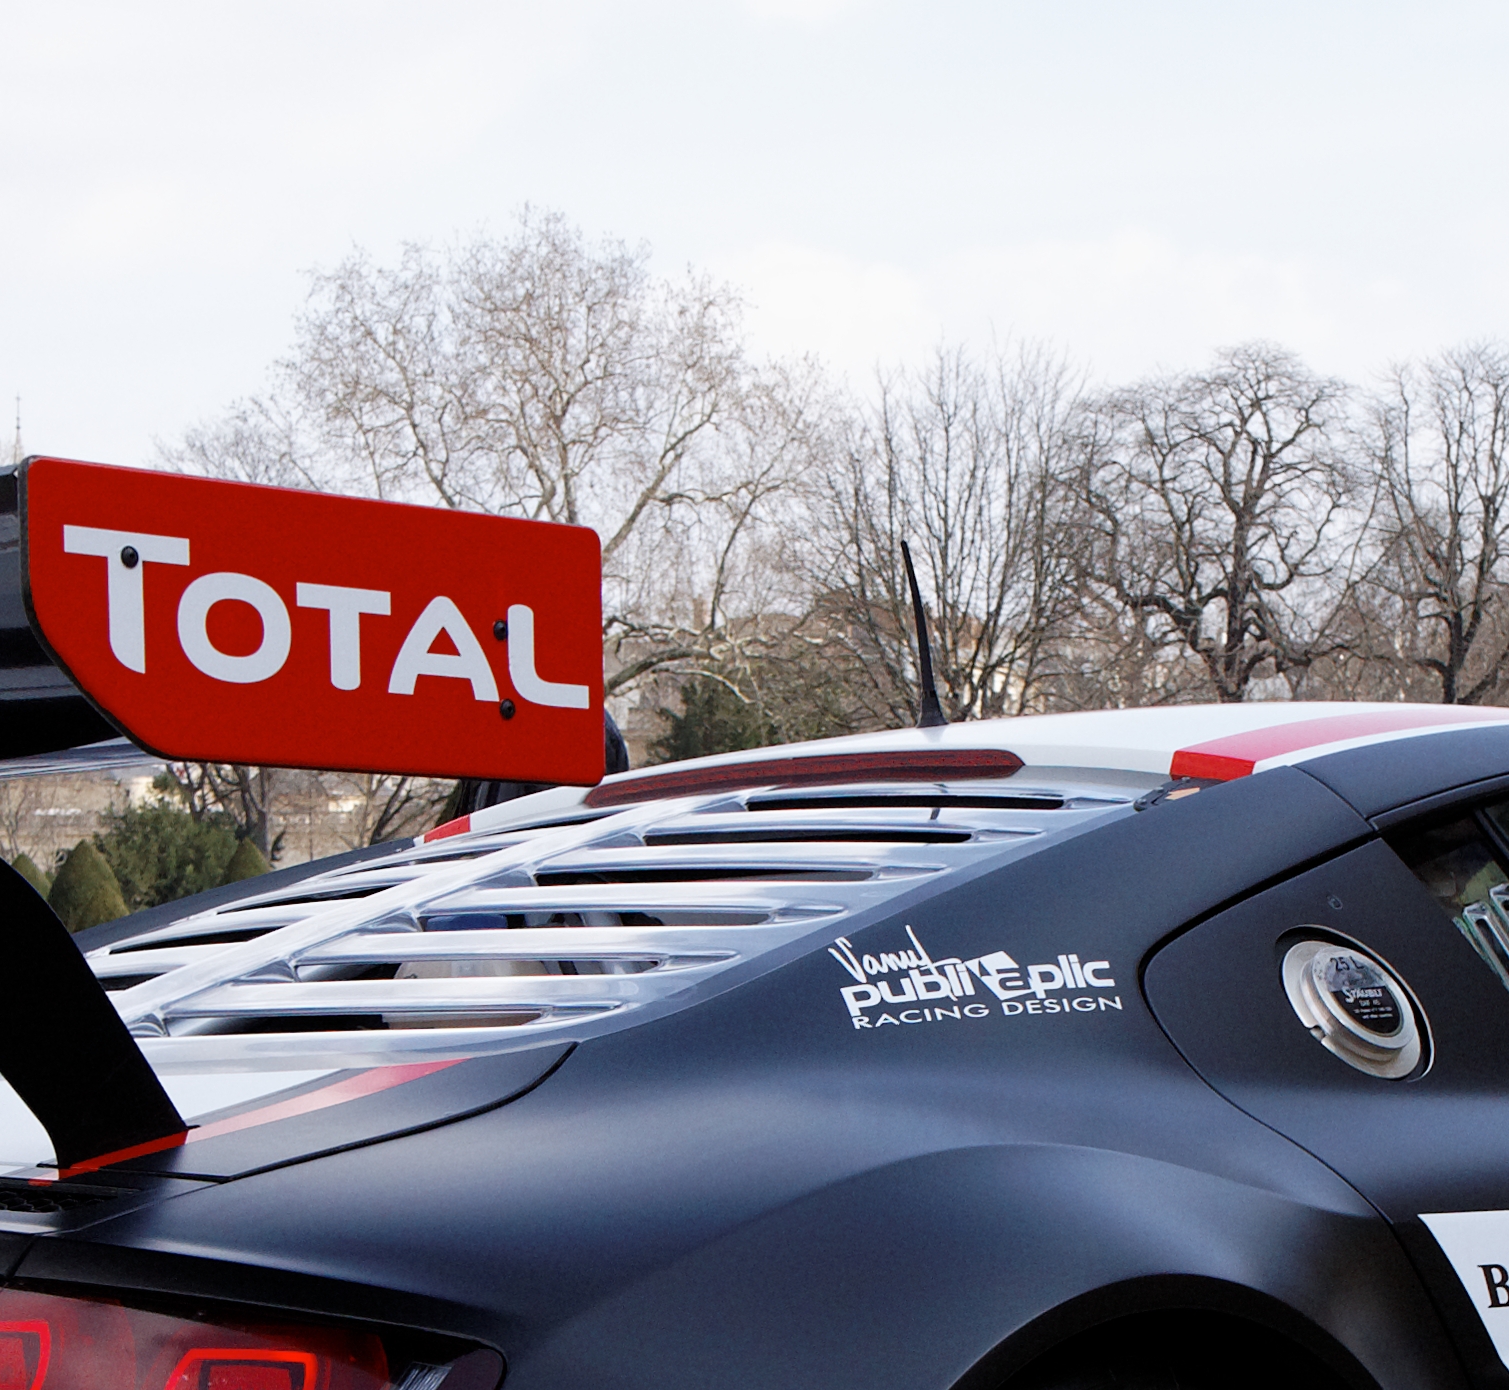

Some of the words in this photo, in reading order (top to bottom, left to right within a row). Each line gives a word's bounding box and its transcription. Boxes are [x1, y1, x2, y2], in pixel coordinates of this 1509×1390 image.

[63, 524, 590, 710] TOTAL
[851, 1003, 990, 1029] RACING
[1001, 996, 1123, 1016] DESIGN
